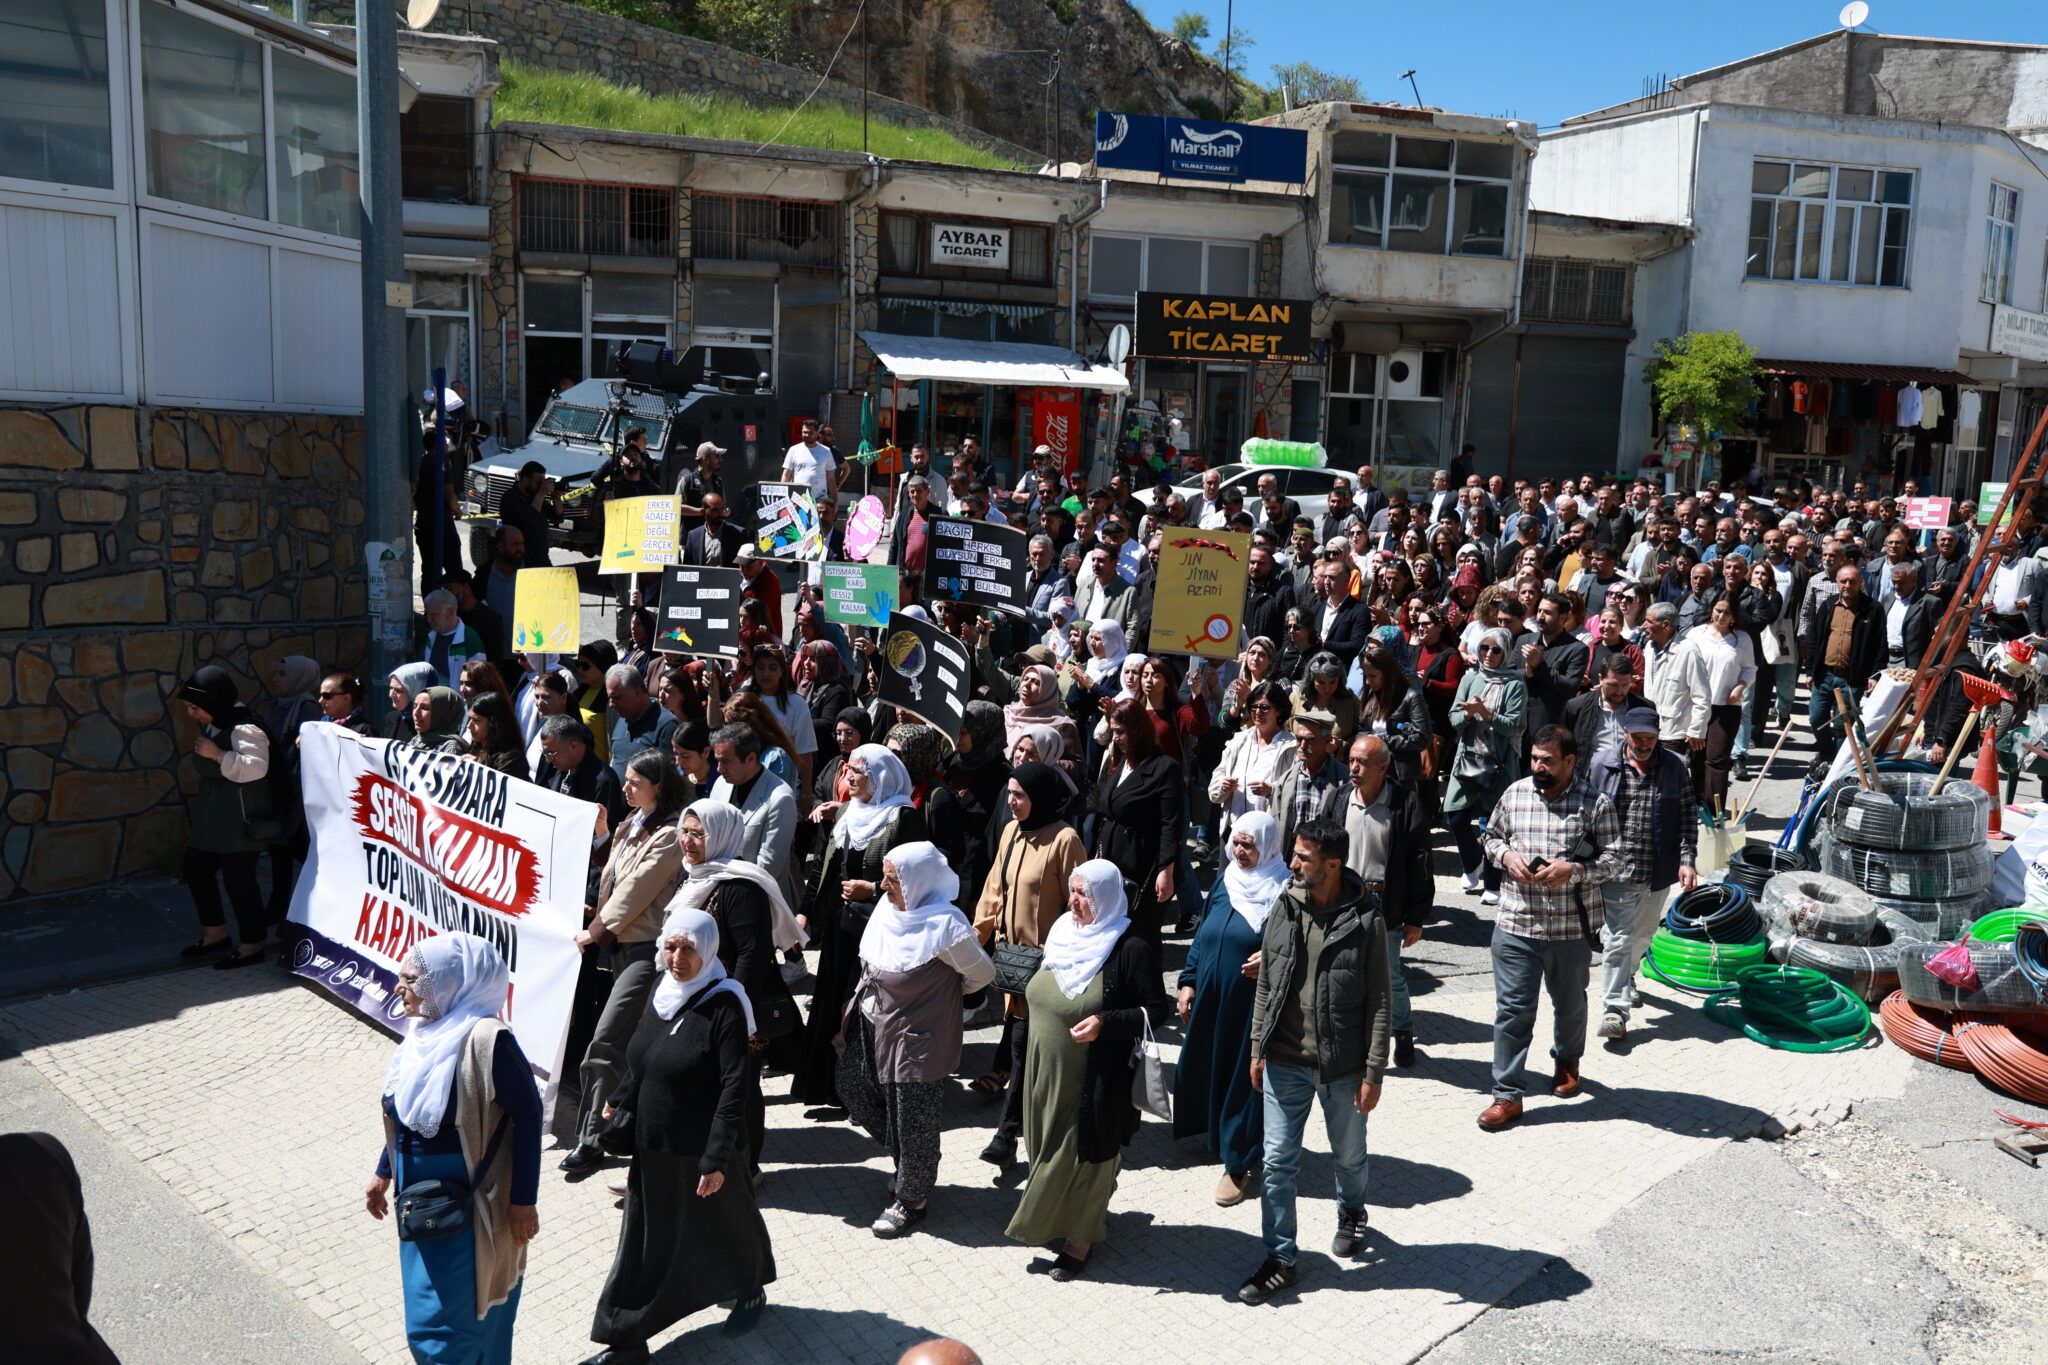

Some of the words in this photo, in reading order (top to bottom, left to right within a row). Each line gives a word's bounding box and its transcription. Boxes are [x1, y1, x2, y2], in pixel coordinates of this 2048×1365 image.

[1170, 138, 1235, 158] Marshall
[938, 229, 1003, 248] AYBAR
[1163, 299, 1291, 324] KAPLAN
[1168, 326, 1283, 354] TİCARET
[647, 501, 670, 510] ERKEK
[644, 512, 674, 521] ADALET
[936, 523, 972, 537] BAĞIR
[642, 540, 672, 550] GERÇEK
[964, 541, 1001, 555] HERKES
[643, 554, 673, 563] ADALET
[937, 550, 977, 562] DUYSUN
[984, 555, 1011, 568] ERKEK
[831, 590, 852, 599] SESSİZ
[976, 581, 1009, 595] BULSUN
[841, 604, 865, 612] KALMA
[370, 782, 422, 858] SESSİZ
[422, 815, 521, 906] KALMAK
[362, 842, 429, 917] TOPLUM
